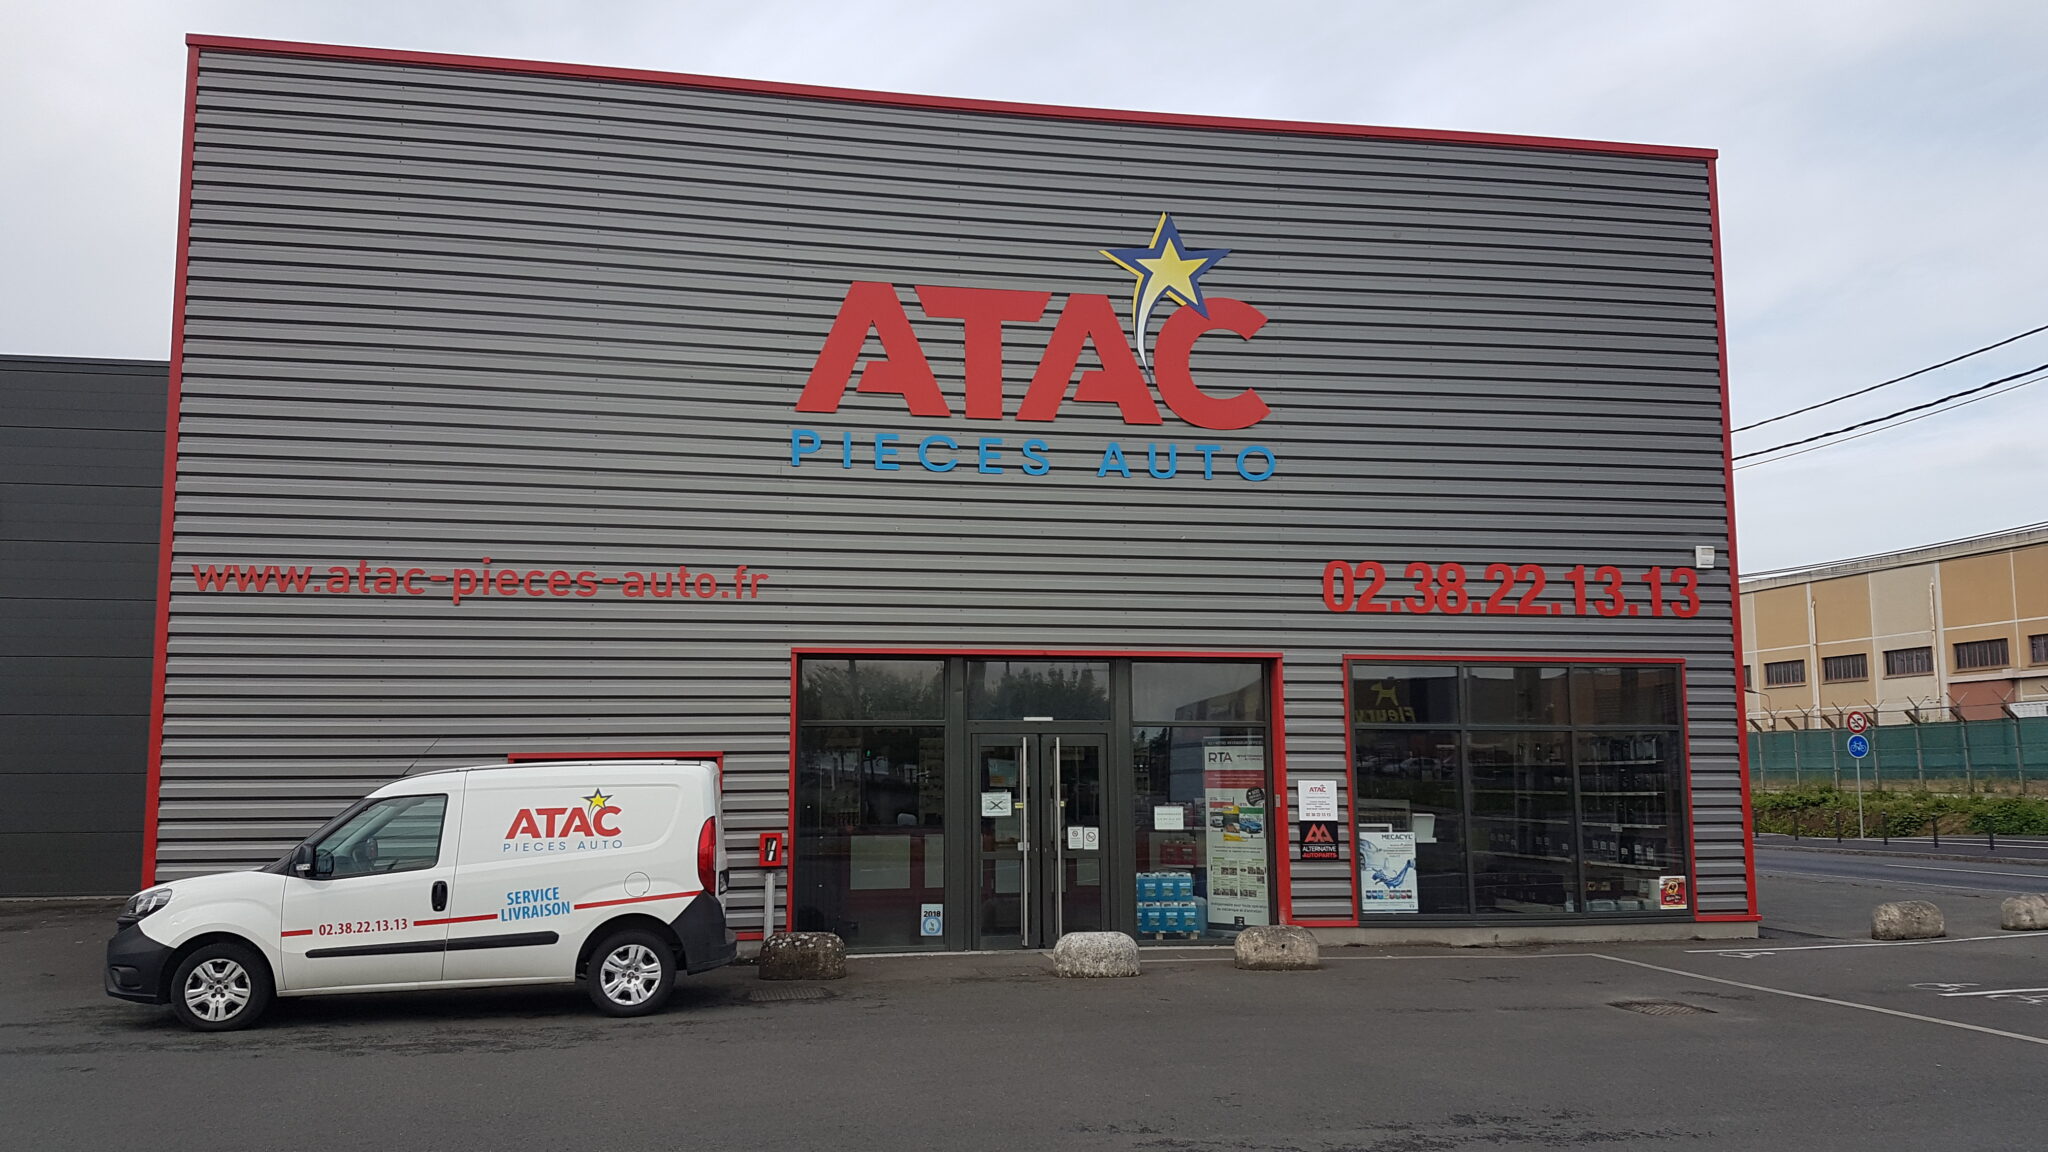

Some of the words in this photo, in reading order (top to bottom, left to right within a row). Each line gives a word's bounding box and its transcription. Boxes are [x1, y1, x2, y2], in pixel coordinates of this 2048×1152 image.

[795, 281, 1272, 431] ATAC
[791, 429, 1050, 476] PIECES
[1097, 442, 1277, 482] AUTO
[192, 556, 769, 606] www.atac-pieces-auto.fr
[1322, 560, 1700, 618] 02.38.22.13.13
[1208, 751, 1233, 763] RTA
[504, 805, 623, 840] ATAC
[503, 841, 566, 853] PIECES
[577, 839, 623, 850] AUTO
[506, 887, 560, 906] SERVICE
[501, 901, 571, 922] LIVRAISON
[923, 910, 942, 918] 2018
[318, 918, 408, 937] 02.38.22.13.13
